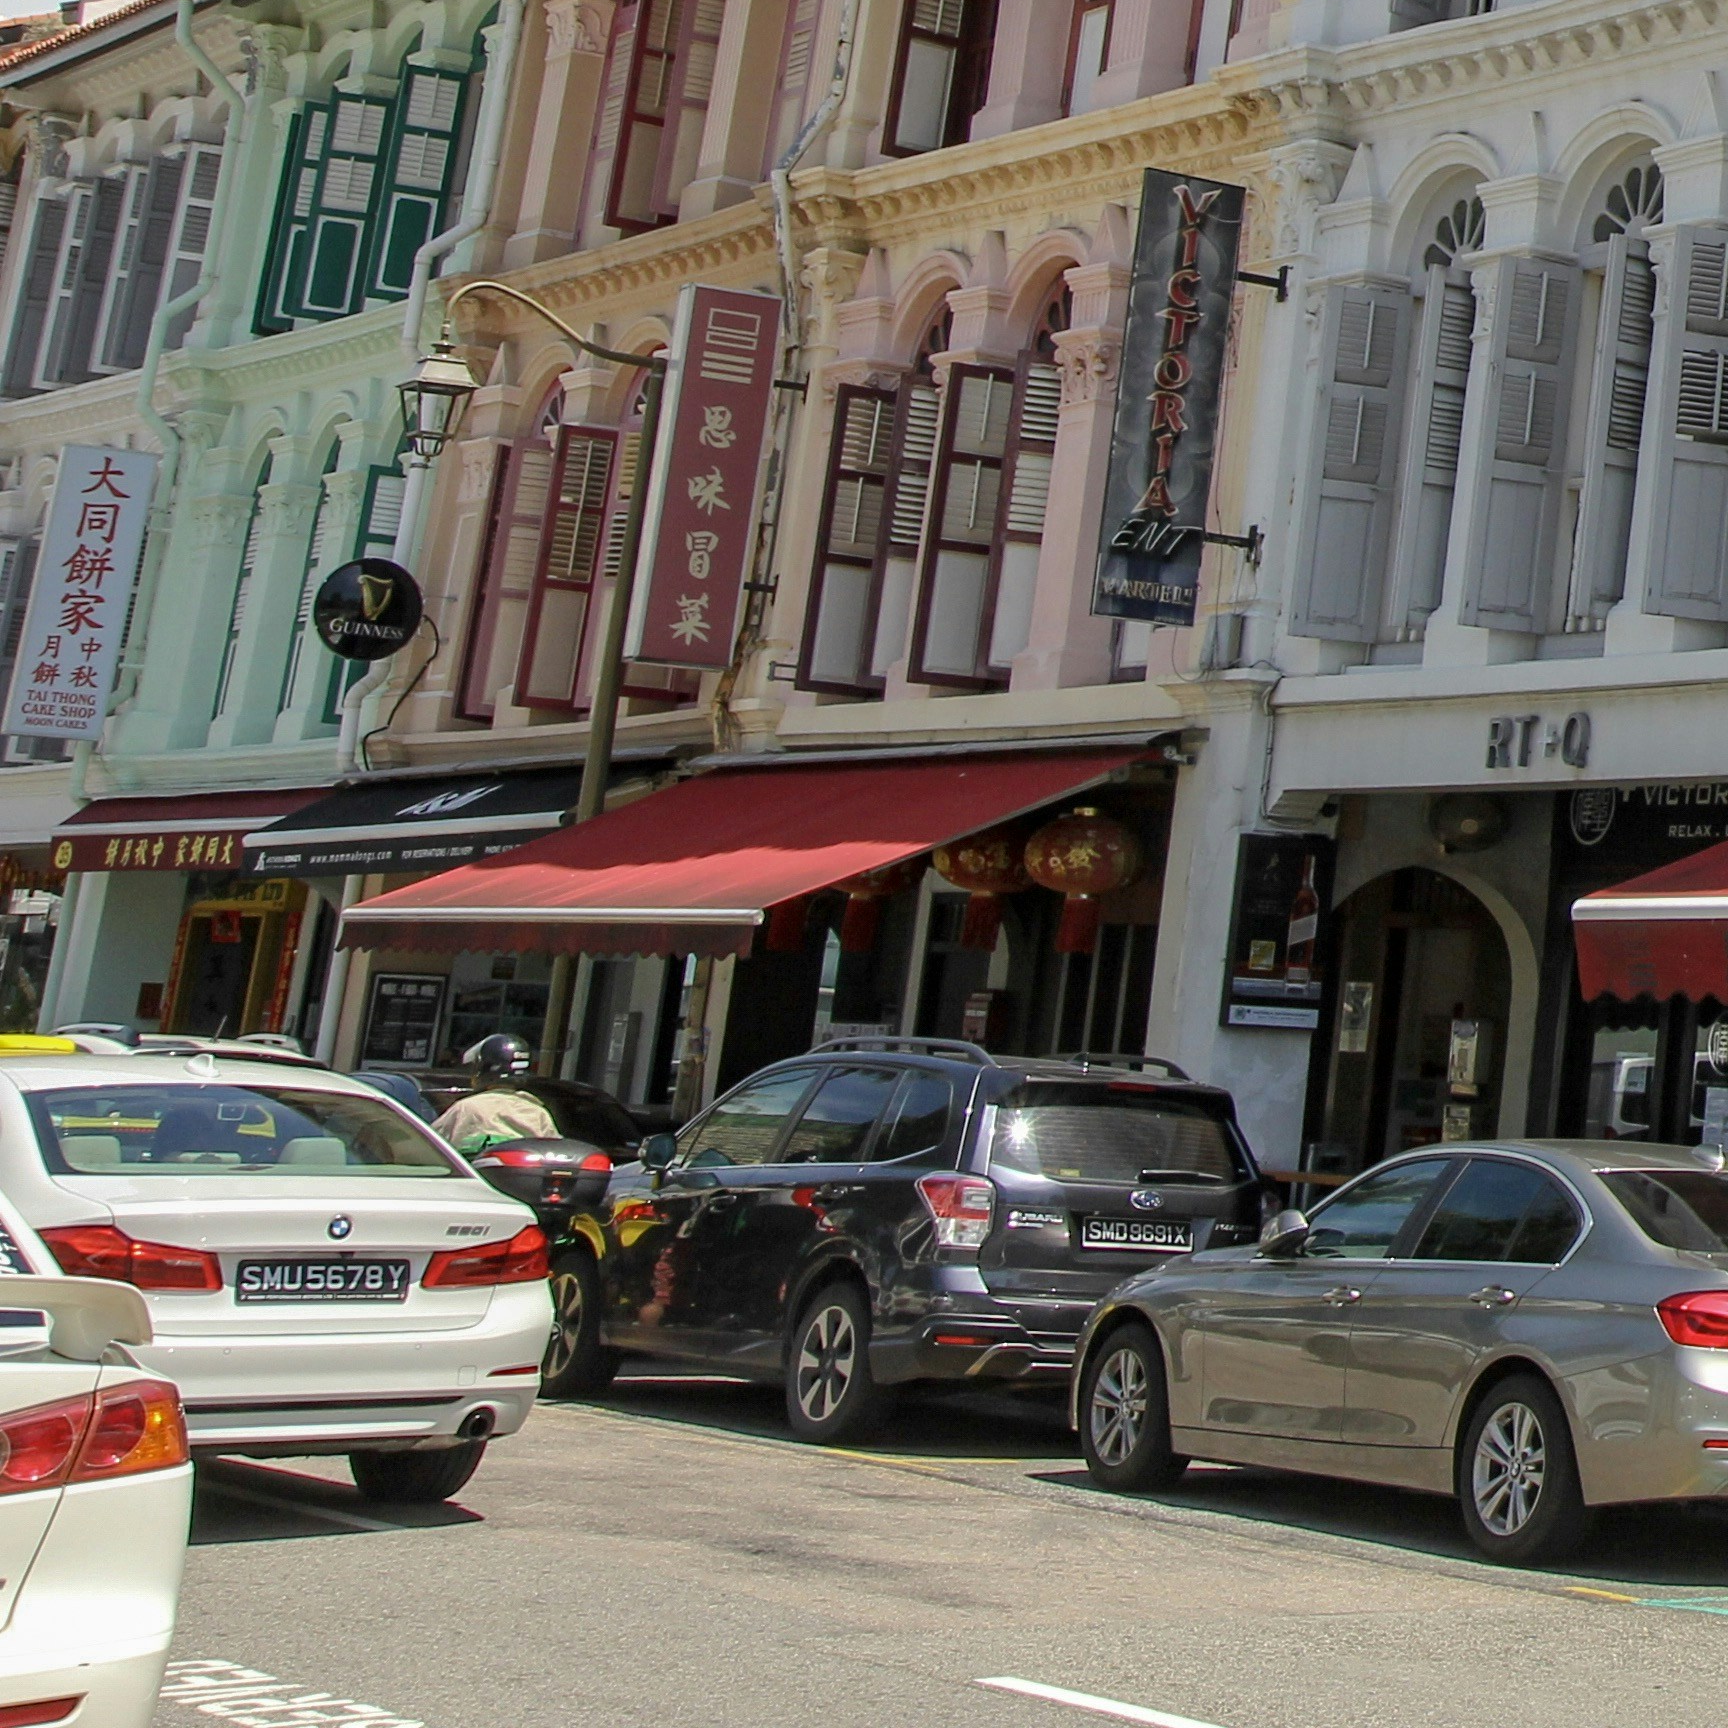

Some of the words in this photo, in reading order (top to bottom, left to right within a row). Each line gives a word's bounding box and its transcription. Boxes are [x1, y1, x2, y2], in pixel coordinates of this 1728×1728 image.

[1133, 183, 1222, 516] VICTORIA
[669, 405, 737, 647] 思味冒菜
[1111, 518, 1204, 556] ENT
[57, 456, 131, 636] 大同餅家
[329, 616, 404, 639] GUINNESS
[27, 689, 48, 702] TAI
[51, 691, 96, 706] THONG
[21, 703, 56, 716] CAKE
[59, 705, 96, 719] SHOP
[55, 719, 88, 730] CAKES
[1486, 712, 1592, 769] RT+Q
[1669, 825, 1711, 838] RELAX
[1088, 1221, 1186, 1244] SMD9691X
[241, 1265, 407, 1291] SMU5678Y
